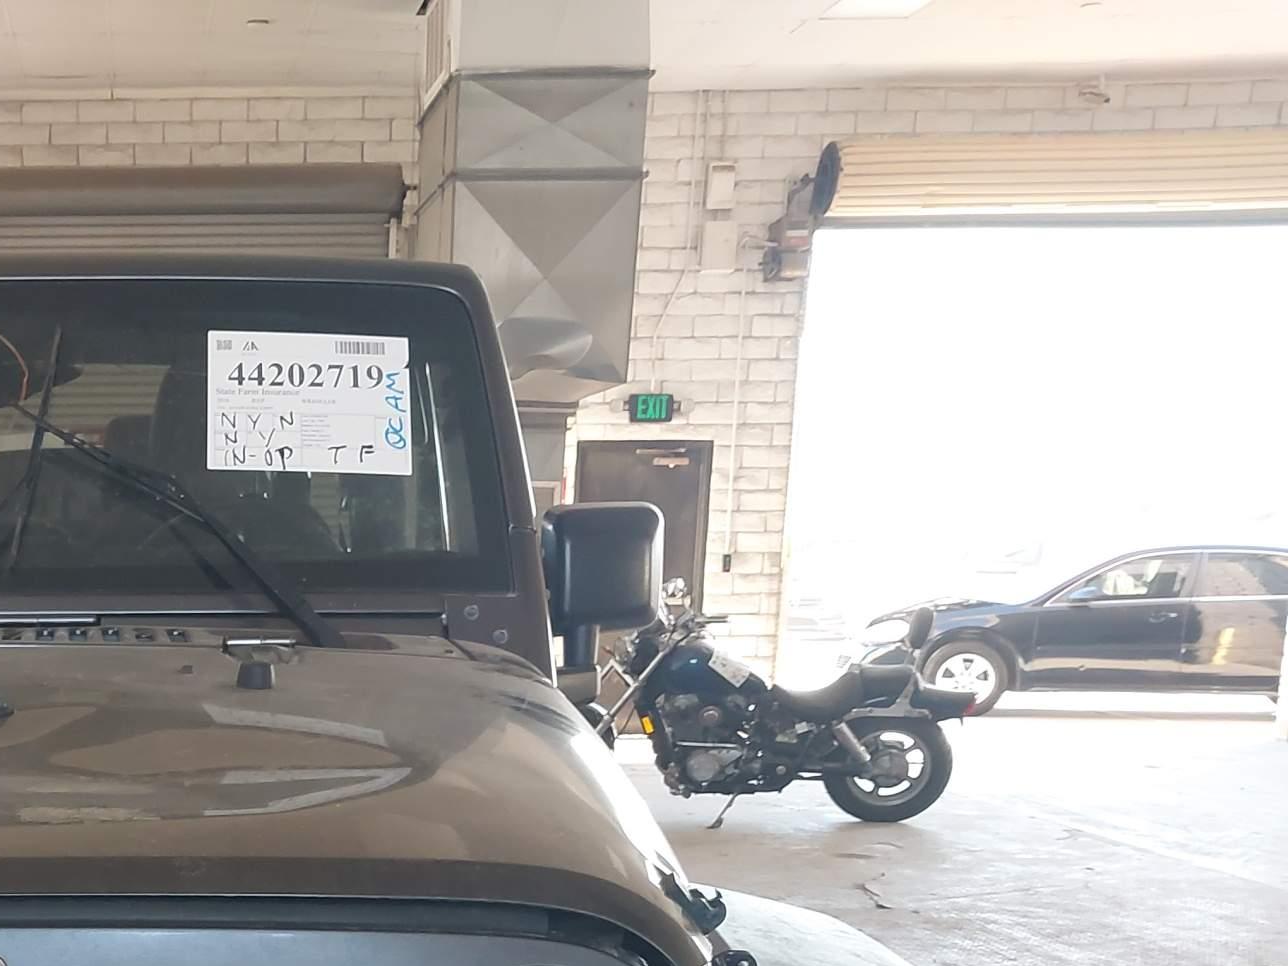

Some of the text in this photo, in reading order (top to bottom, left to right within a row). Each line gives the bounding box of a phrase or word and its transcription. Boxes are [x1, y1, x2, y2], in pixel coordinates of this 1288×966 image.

[228, 362, 384, 389] 44202719
[637, 395, 669, 419] EXIT
[221, 411, 294, 430] N Y N
[224, 430, 238, 446] N
[328, 445, 347, 465] T
[359, 445, 375, 463] F
